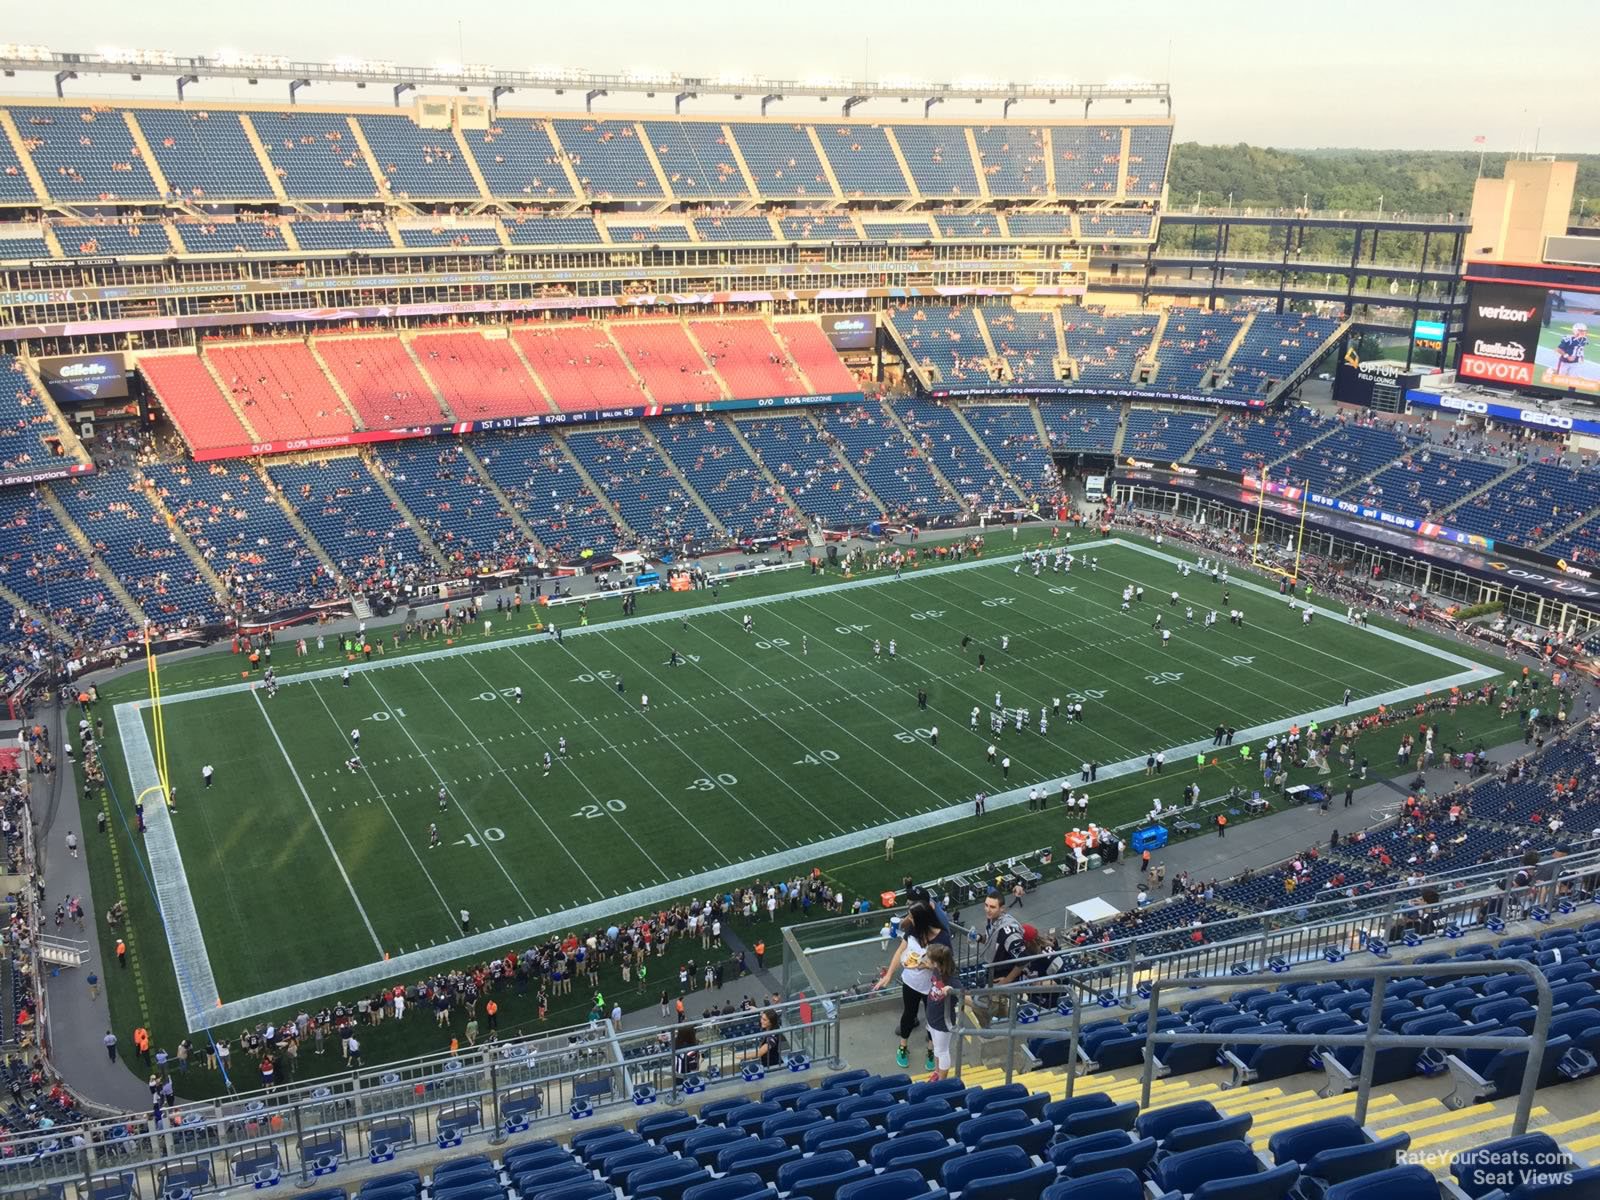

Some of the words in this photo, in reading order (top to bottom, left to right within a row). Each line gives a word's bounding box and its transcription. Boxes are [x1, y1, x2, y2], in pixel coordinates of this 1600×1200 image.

[1478, 306, 1527, 322] verizon
[60, 363, 106, 377] Gillette
[1359, 362, 1399, 378] OPTUM
[1463, 359, 1529, 381] TOYOTA
[1358, 372, 1374, 381] FIELD
[1374, 375, 1397, 386] LOUNGE
[758, 398, 774, 406] 0/0
[1205, 396, 1223, 404] dining
[1440, 395, 1488, 414] GEICO
[481, 420, 493, 429] 1ST
[503, 419, 512, 427] 10
[545, 415, 566, 423] 47:40
[1520, 410, 1573, 429] GEICO
[252, 444, 272, 453] 0/0
[286, 440, 308, 449] 0.0%
[309, 436, 349, 446] REDZONE
[4, 475, 32, 485] dining
[1338, 501, 1358, 513] 47:40
[1381, 512, 1395, 523] BALL
[1395, 516, 1405, 525] ON
[1405, 519, 1415, 528] 45
[1566, 565, 1592, 578] OPTUM
[1507, 569, 1600, 597] OPTUM
[982, 596, 1012, 608] 20
[911, 609, 941, 620] 30
[835, 624, 862, 635] 40
[755, 637, 791, 650] 50
[1221, 655, 1254, 667] 10
[577, 669, 616, 684] 30
[1145, 671, 1181, 686] 20
[479, 687, 517, 702] 20
[1066, 688, 1104, 704] 30
[373, 707, 408, 722] 10
[893, 726, 934, 744] 50
[804, 749, 842, 767] 40
[694, 773, 738, 792] 30
[580, 798, 628, 820] 20
[461, 827, 506, 848] 10
